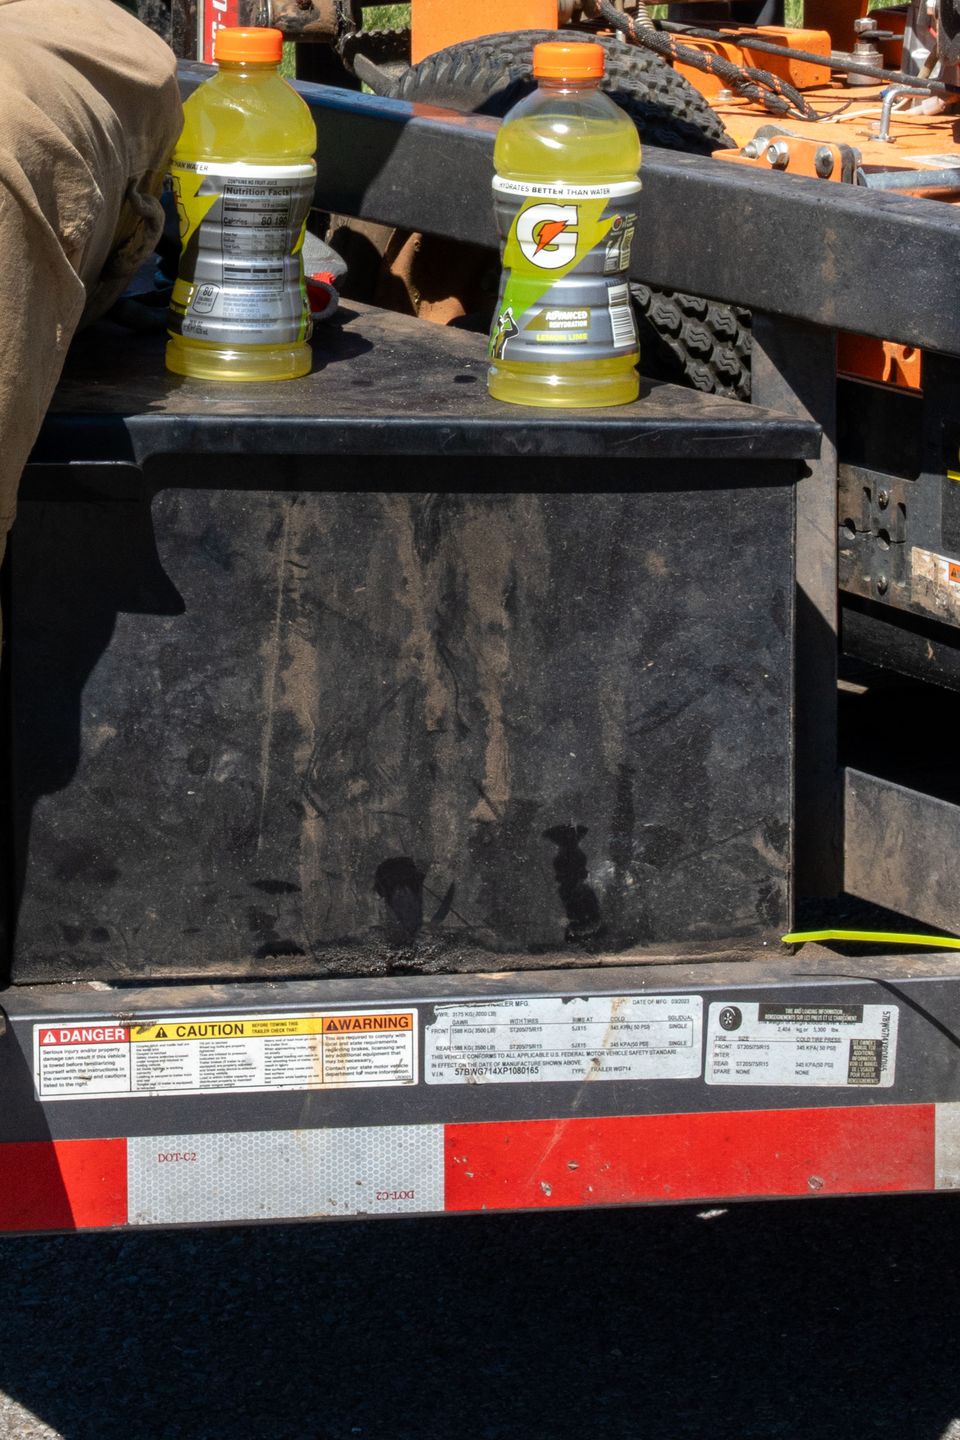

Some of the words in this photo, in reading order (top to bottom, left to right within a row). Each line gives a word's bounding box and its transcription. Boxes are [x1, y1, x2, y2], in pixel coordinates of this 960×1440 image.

[227, 187, 265, 196] Nutrition
[500, 183, 530, 192] HYDRATES
[338, 1017, 408, 1030] WARNING
[60, 1028, 125, 1042] DANGER
[176, 1024, 244, 1037] CAUTION
[157, 1152, 197, 1163] DOT-C2
[376, 1190, 415, 1201] DOT-C2
